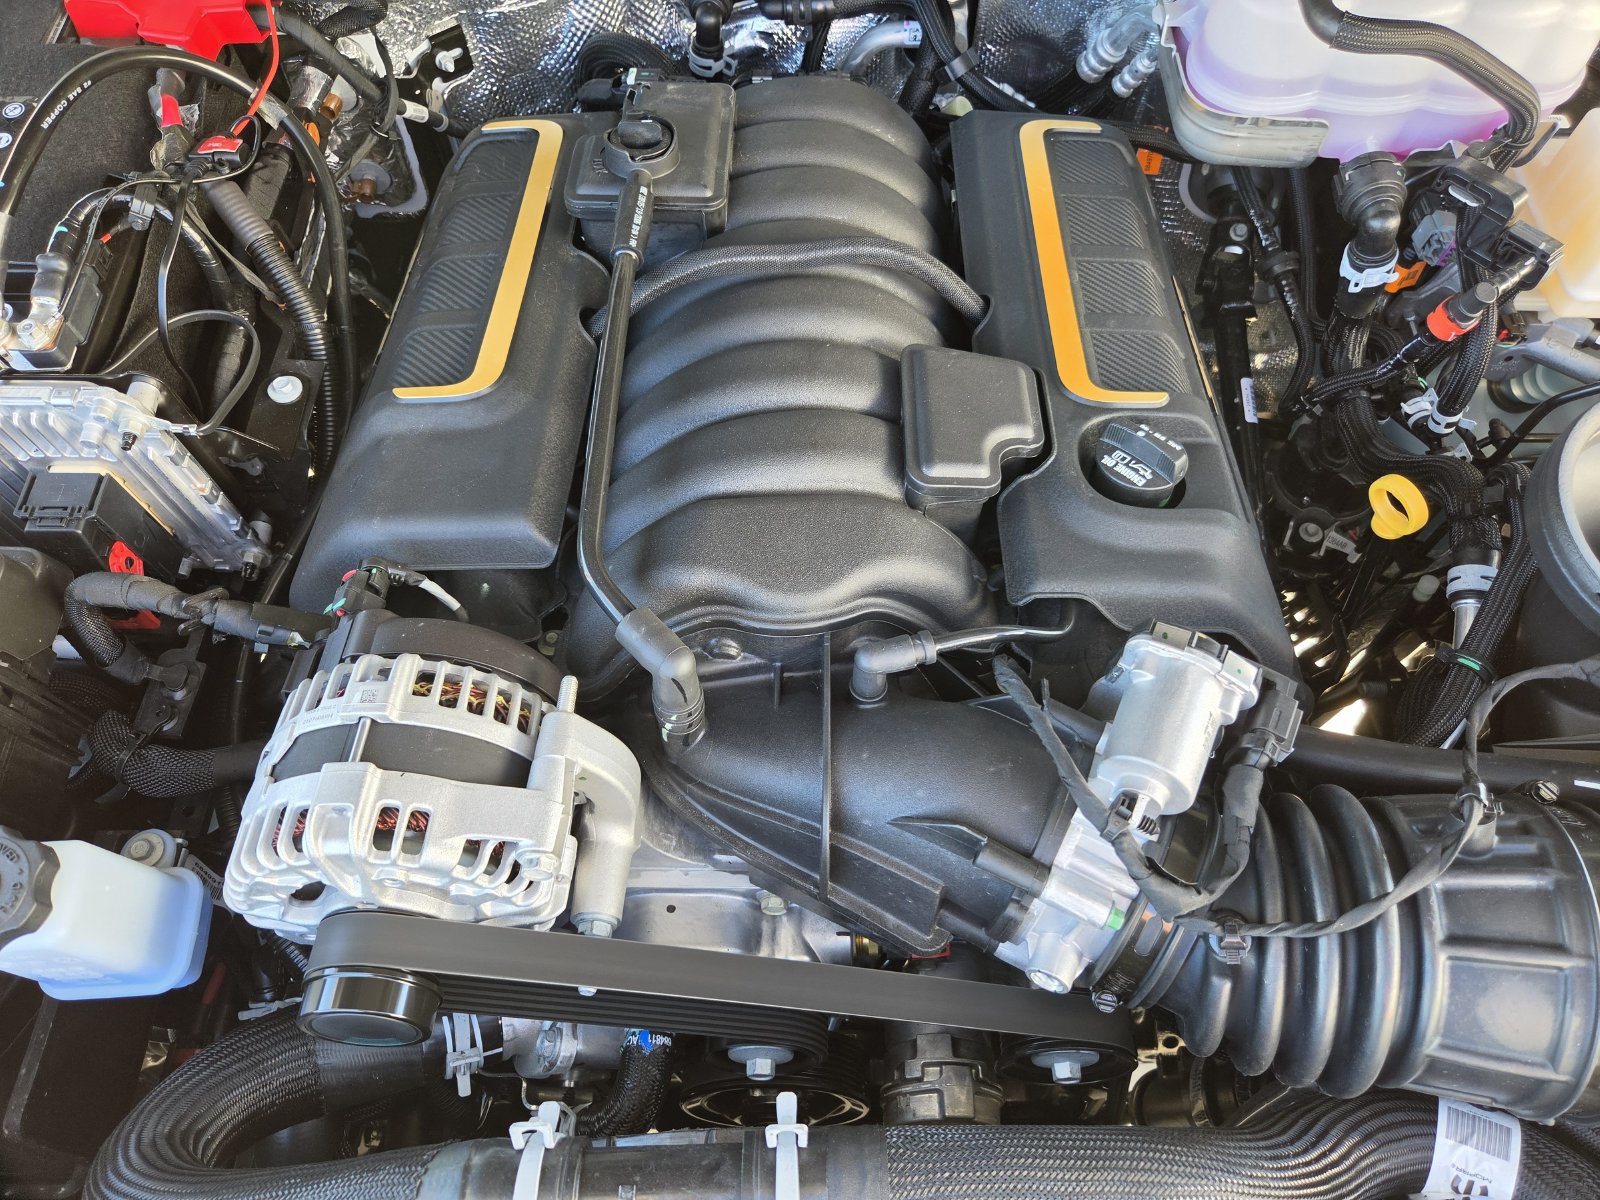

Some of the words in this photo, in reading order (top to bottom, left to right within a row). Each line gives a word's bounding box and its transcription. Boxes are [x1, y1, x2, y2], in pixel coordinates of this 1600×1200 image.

[67, 86, 82, 101] SAE
[40, 99, 68, 129] COPPER
[1100, 454, 1118, 467] OIL
[1112, 462, 1148, 487] ENGINE
[1455, 1166, 1493, 1185] MOPAR
